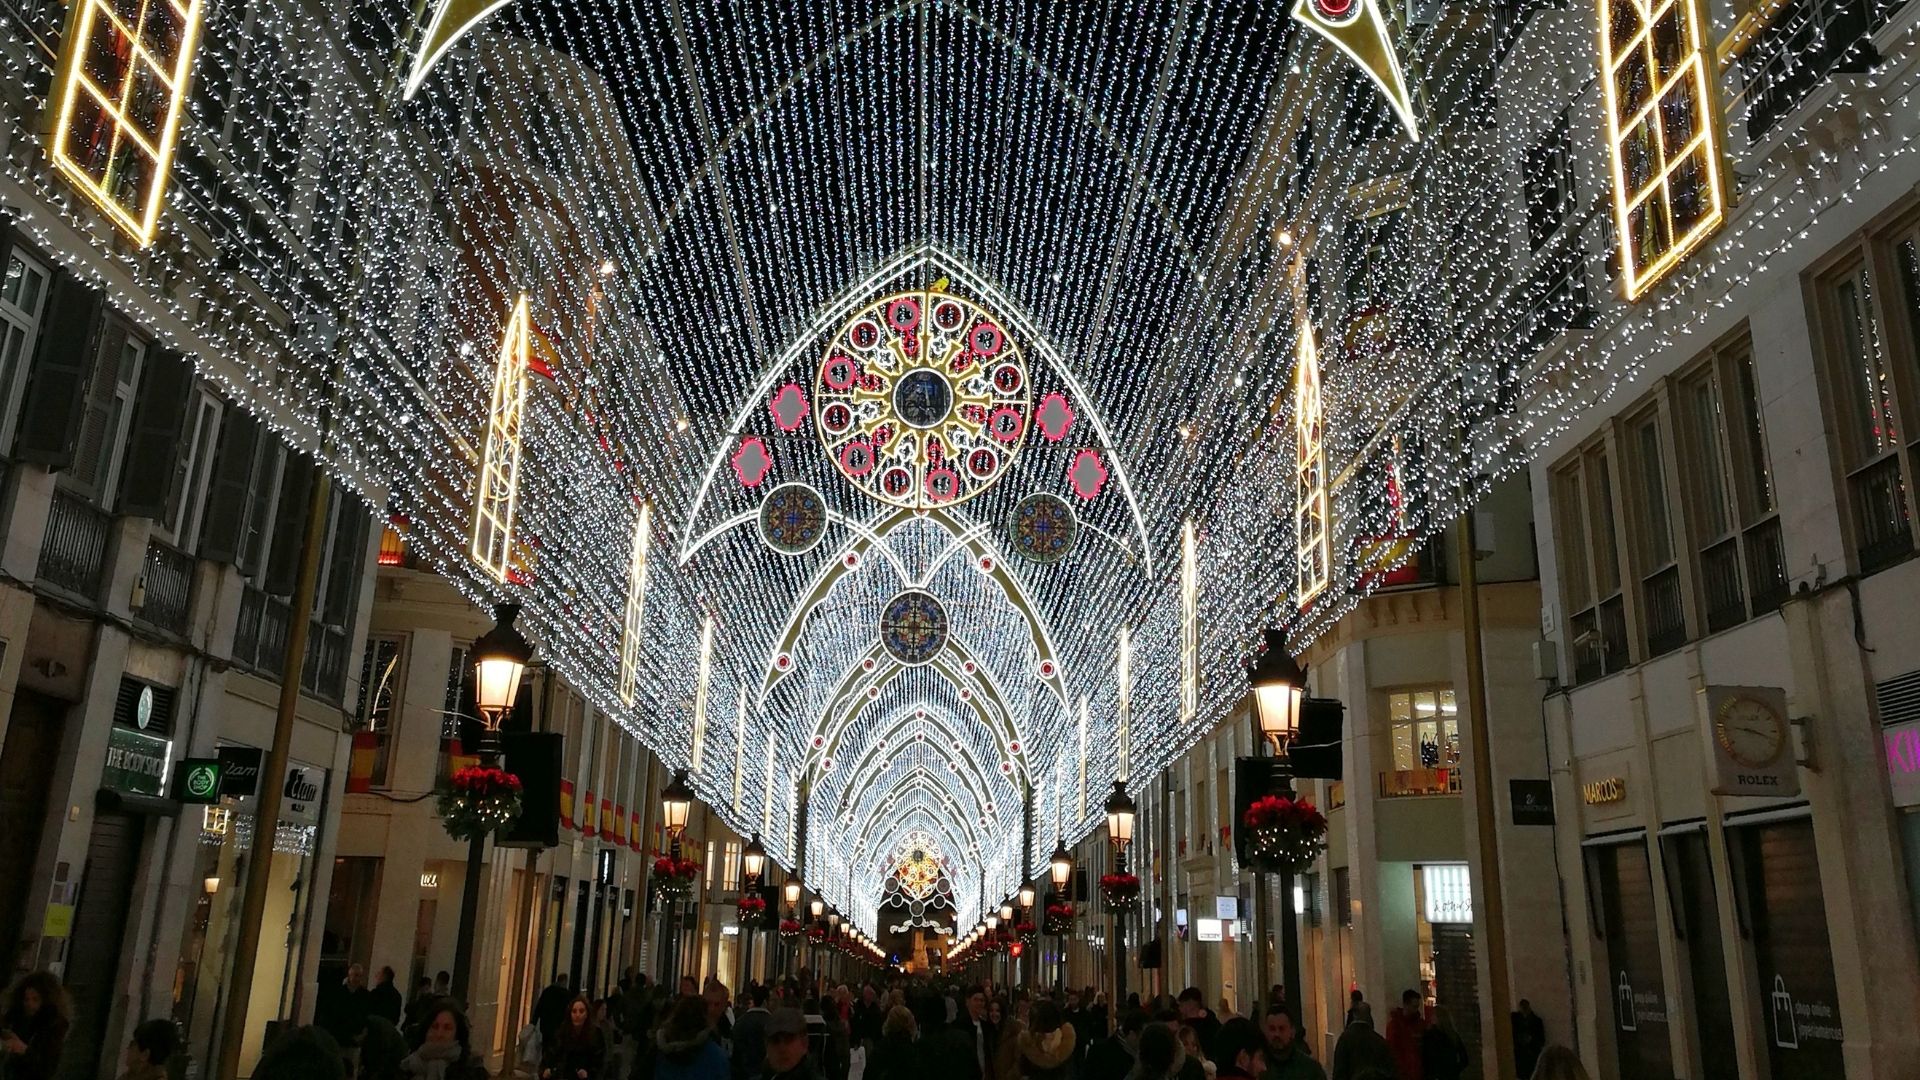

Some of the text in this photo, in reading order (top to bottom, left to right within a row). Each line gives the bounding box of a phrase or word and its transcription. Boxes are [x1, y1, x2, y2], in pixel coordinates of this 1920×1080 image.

[106, 746, 123, 769] THE
[123, 751, 145, 774] BODY
[1583, 777, 1618, 804] MARCOS
[1738, 775, 1778, 786] ROLEX
